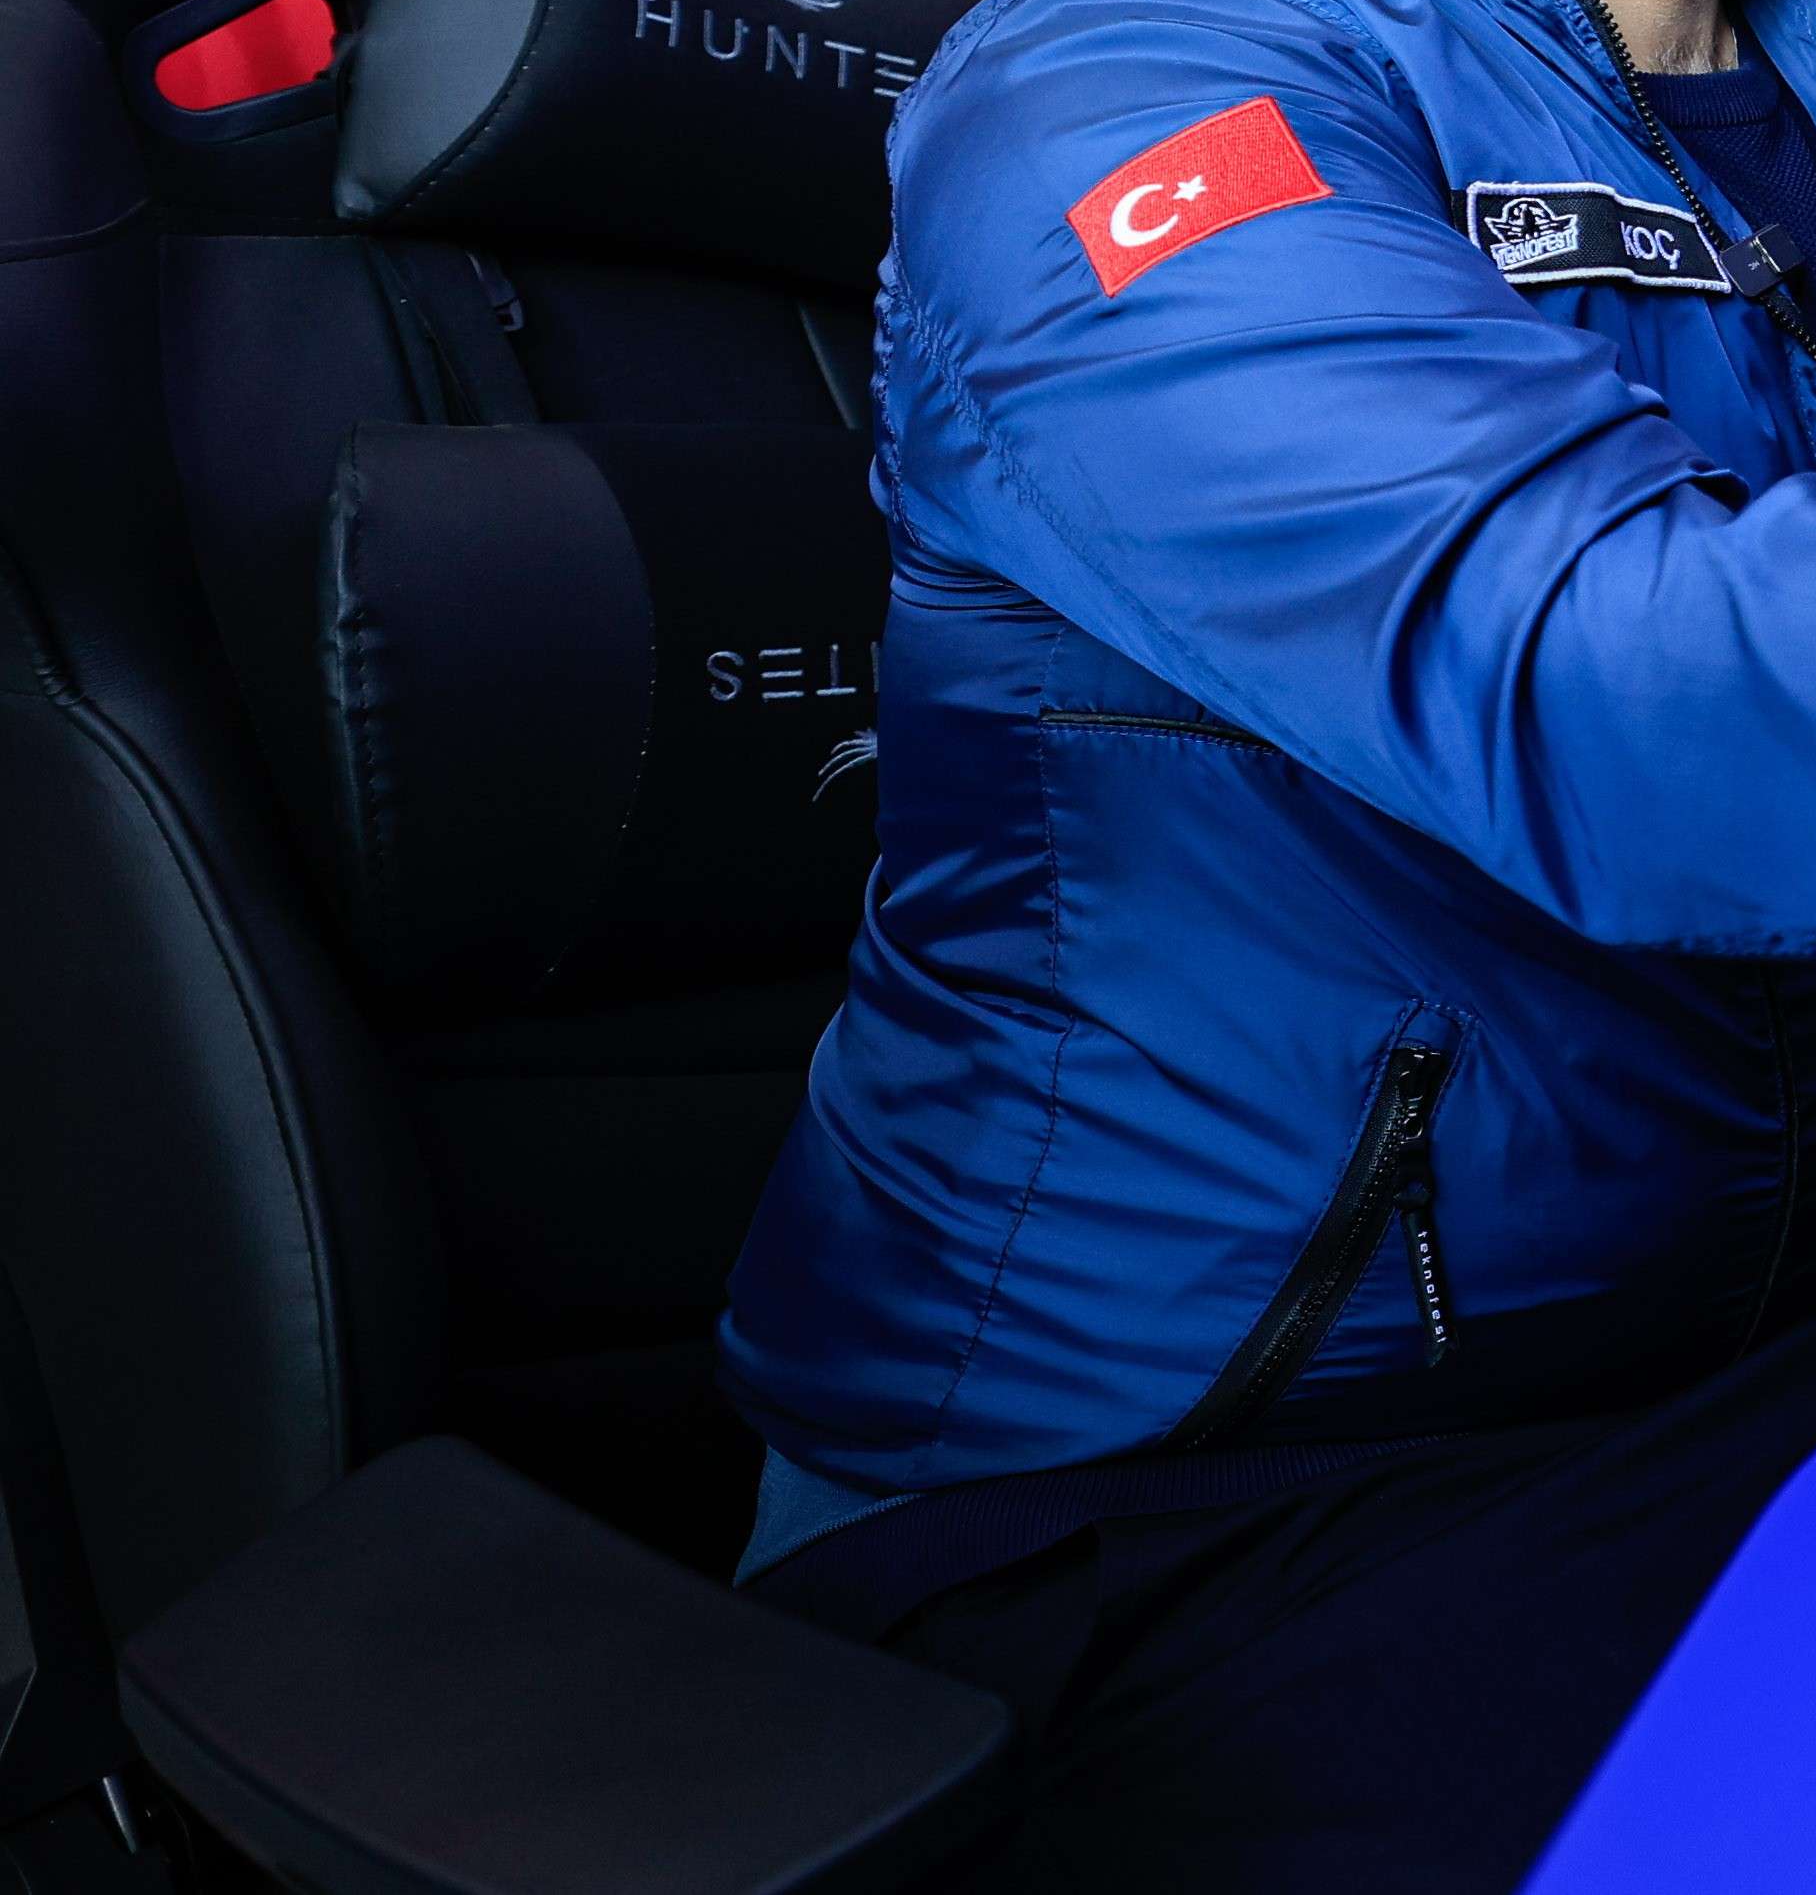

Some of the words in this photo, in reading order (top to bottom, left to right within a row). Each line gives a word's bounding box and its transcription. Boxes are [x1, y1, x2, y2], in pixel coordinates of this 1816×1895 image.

[1494, 227, 1578, 270] TEKNOFEST
[1619, 220, 1681, 271] KOÇ
[705, 640, 880, 702] TES
